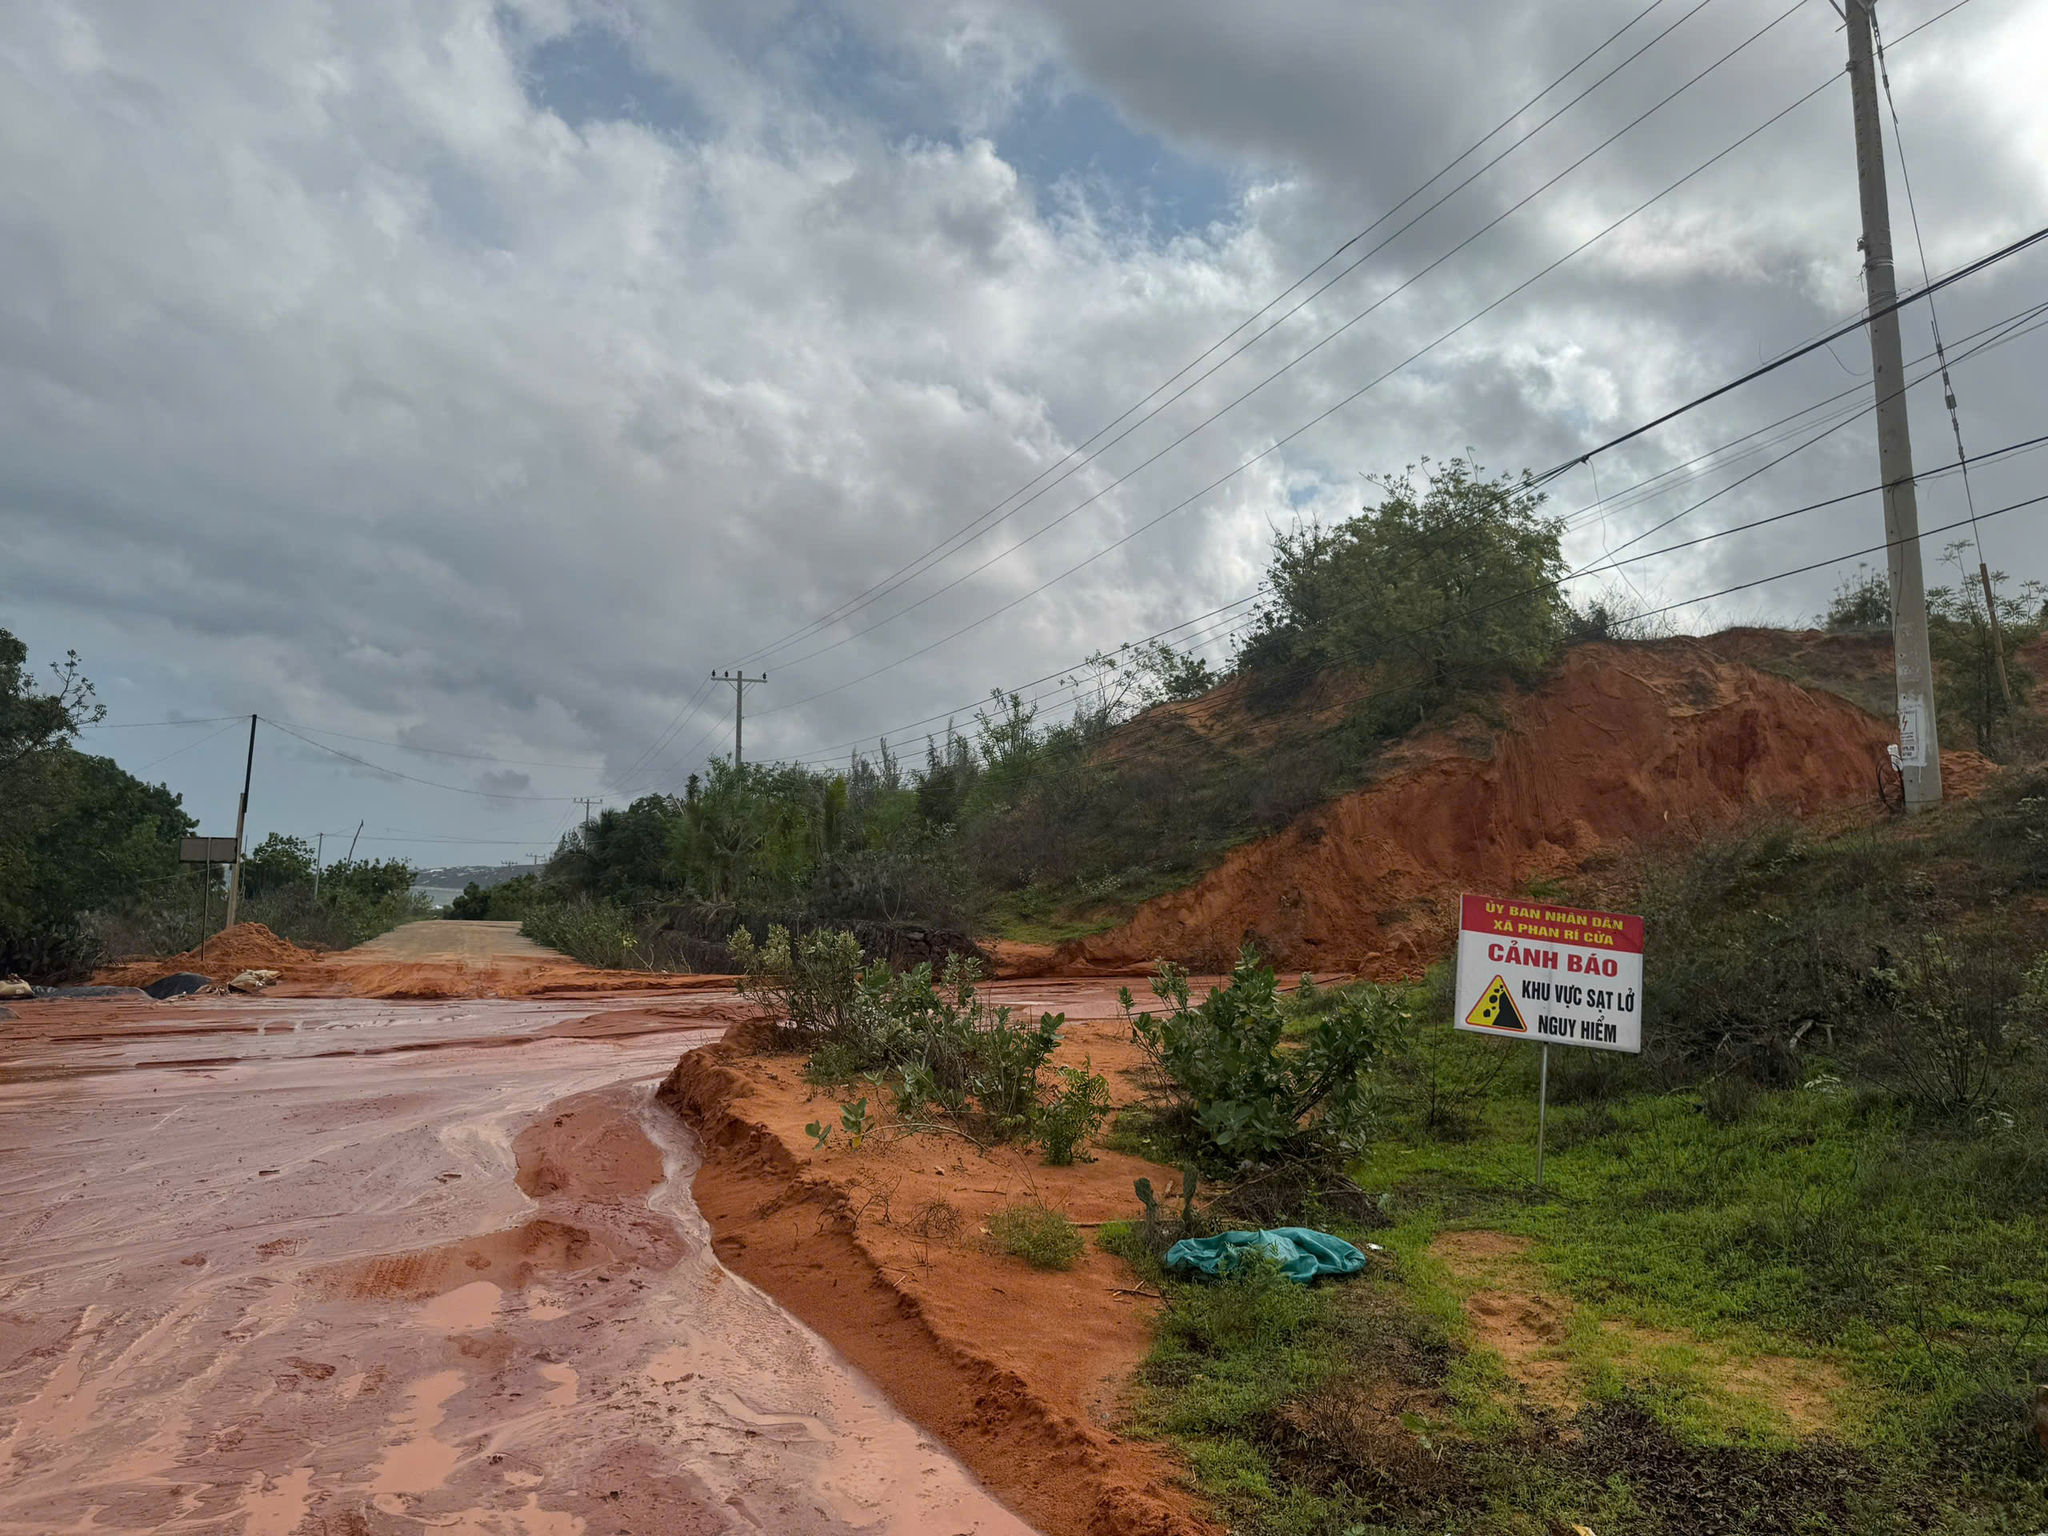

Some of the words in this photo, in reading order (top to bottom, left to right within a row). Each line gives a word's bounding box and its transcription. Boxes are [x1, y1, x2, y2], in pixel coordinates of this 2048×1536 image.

[1509, 905, 1541, 920] BAN
[1545, 911, 1588, 926] NHÂN
[1592, 916, 1623, 930] DÂN
[1518, 923, 1559, 938] PHAN
[1564, 928, 1579, 940] RÍ
[1488, 940, 1558, 970] CẢNH
[1567, 953, 1618, 977] BÁO
[1522, 980, 1550, 1001] KHU
[1555, 984, 1582, 1009] VỰC
[1587, 989, 1613, 1013] SẠT
[1617, 987, 1635, 1012] LỞ
[1538, 1015, 1576, 1037] NGUY
[1581, 1015, 1617, 1043] HIỂM
